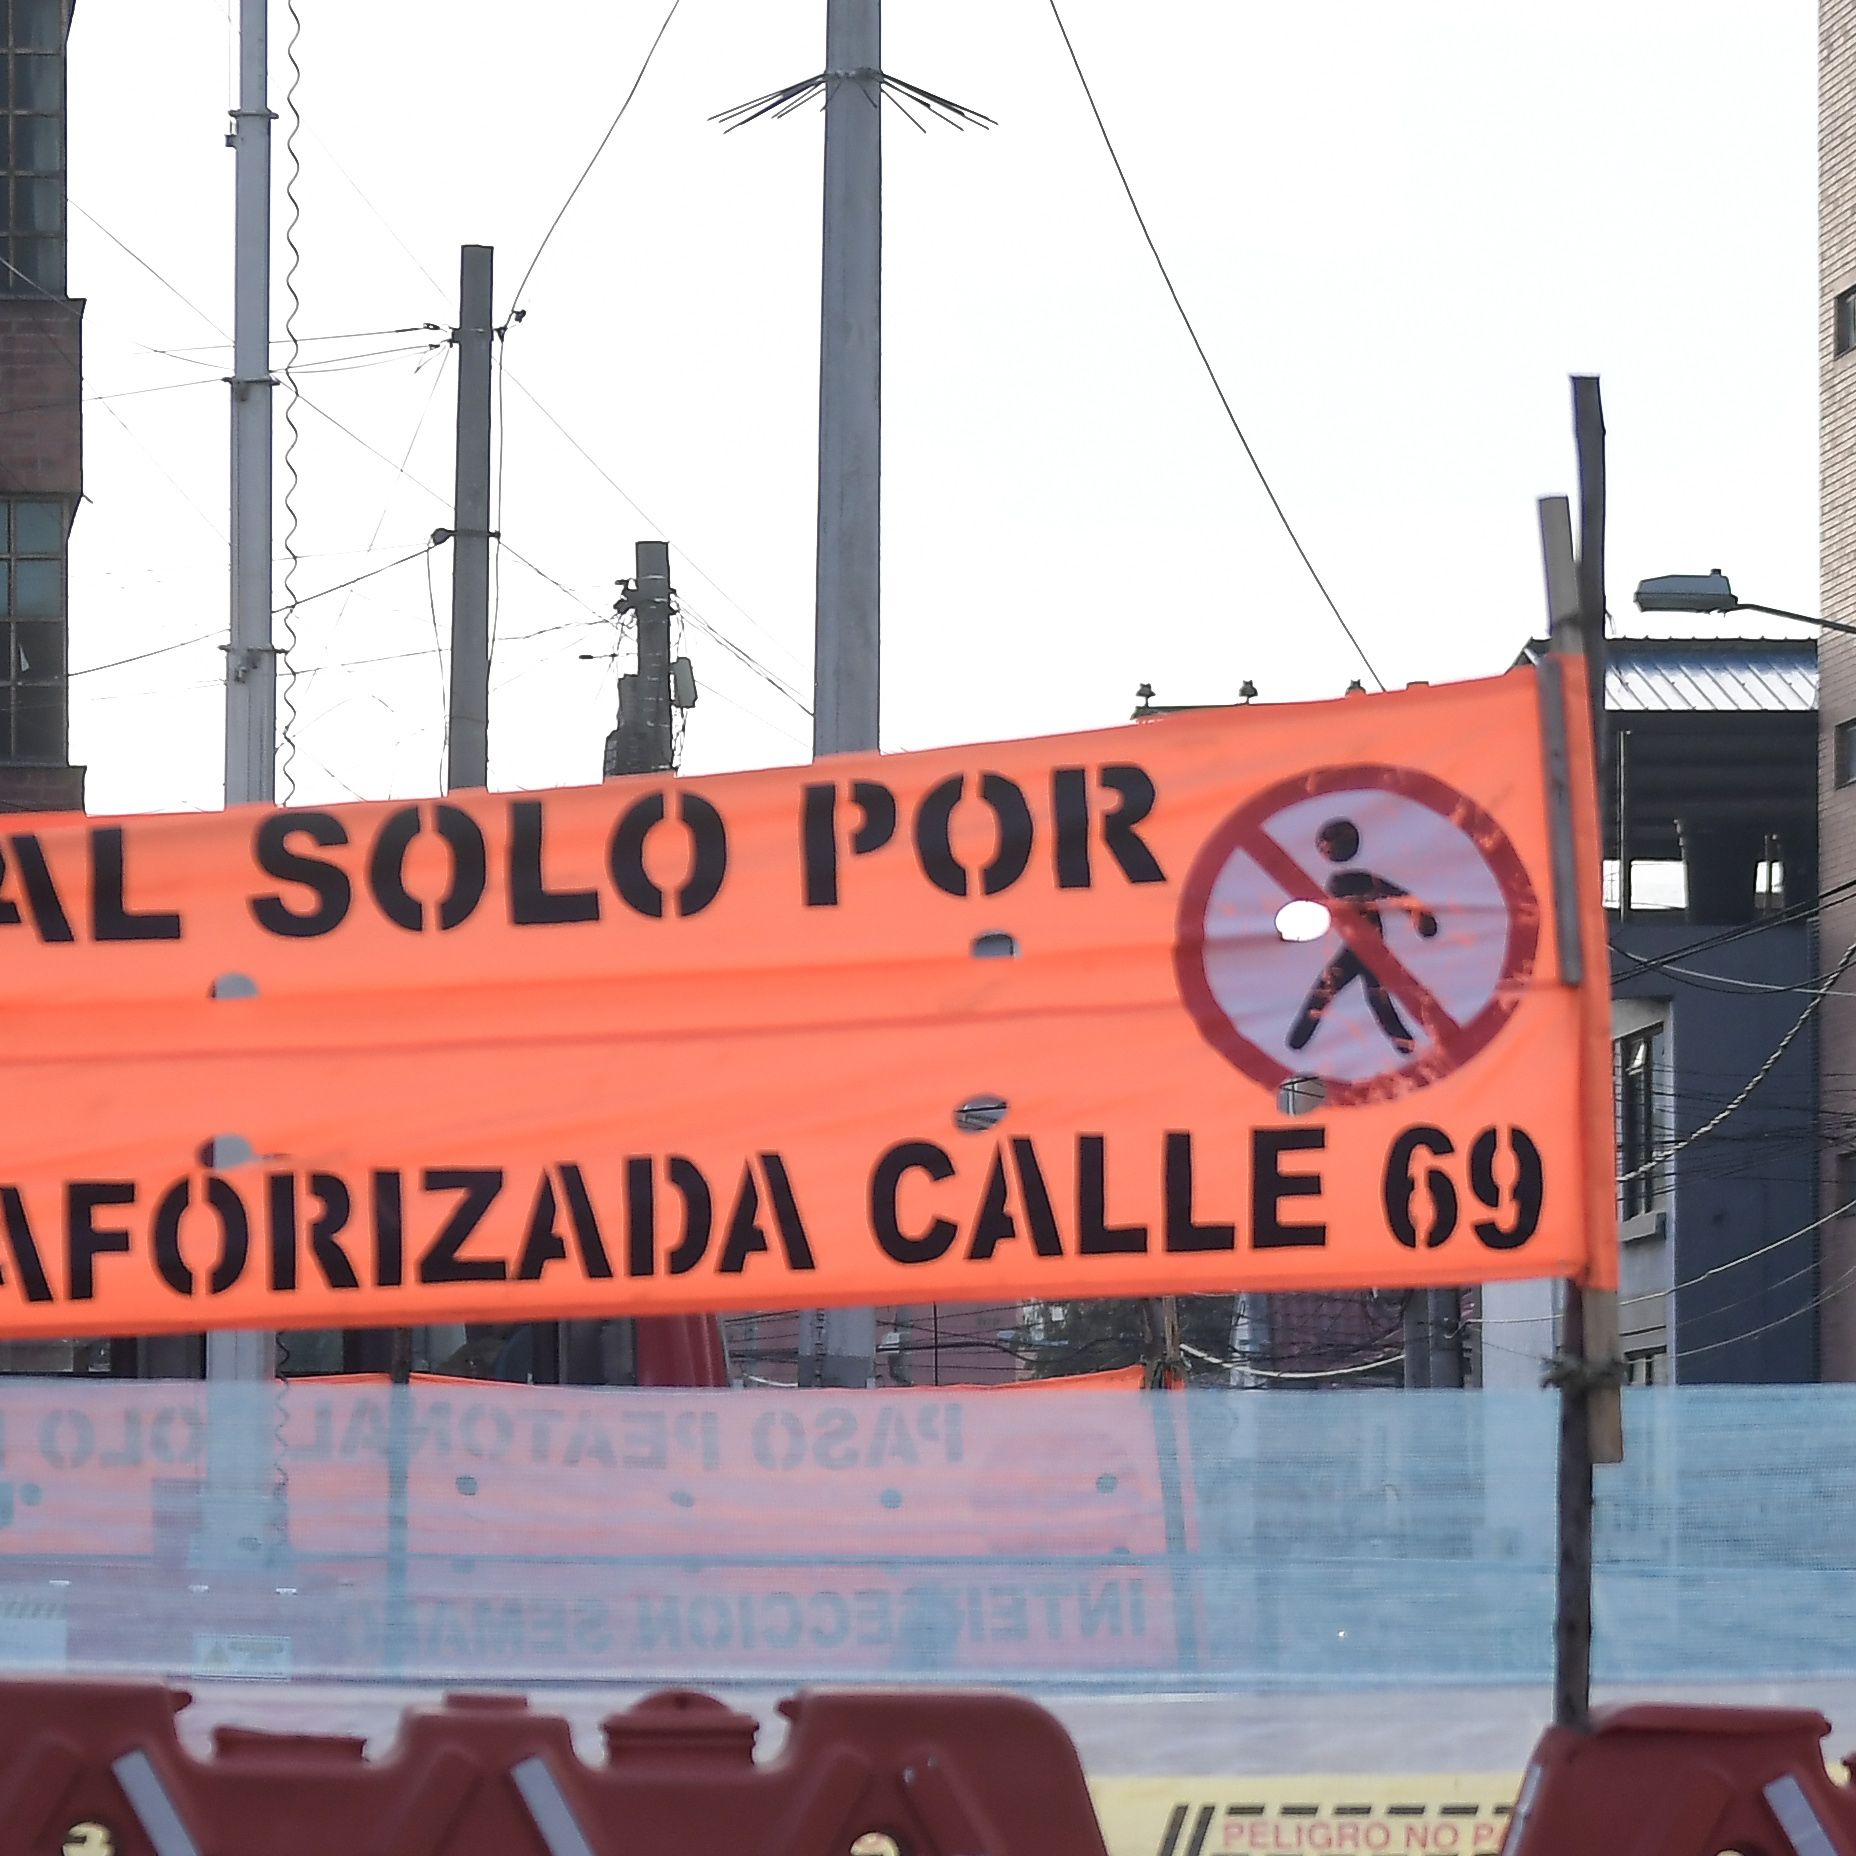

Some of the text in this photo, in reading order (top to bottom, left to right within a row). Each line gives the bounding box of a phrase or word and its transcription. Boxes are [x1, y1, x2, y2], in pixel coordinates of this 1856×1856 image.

[252, 792, 727, 938] SOLO
[803, 763, 1166, 906] POR
[871, 1128, 1328, 1264] CALLE
[1383, 1126, 1544, 1250] 69
[1223, 1821, 1392, 1851] PELIGRO
[1404, 1820, 1460, 1848] NO
